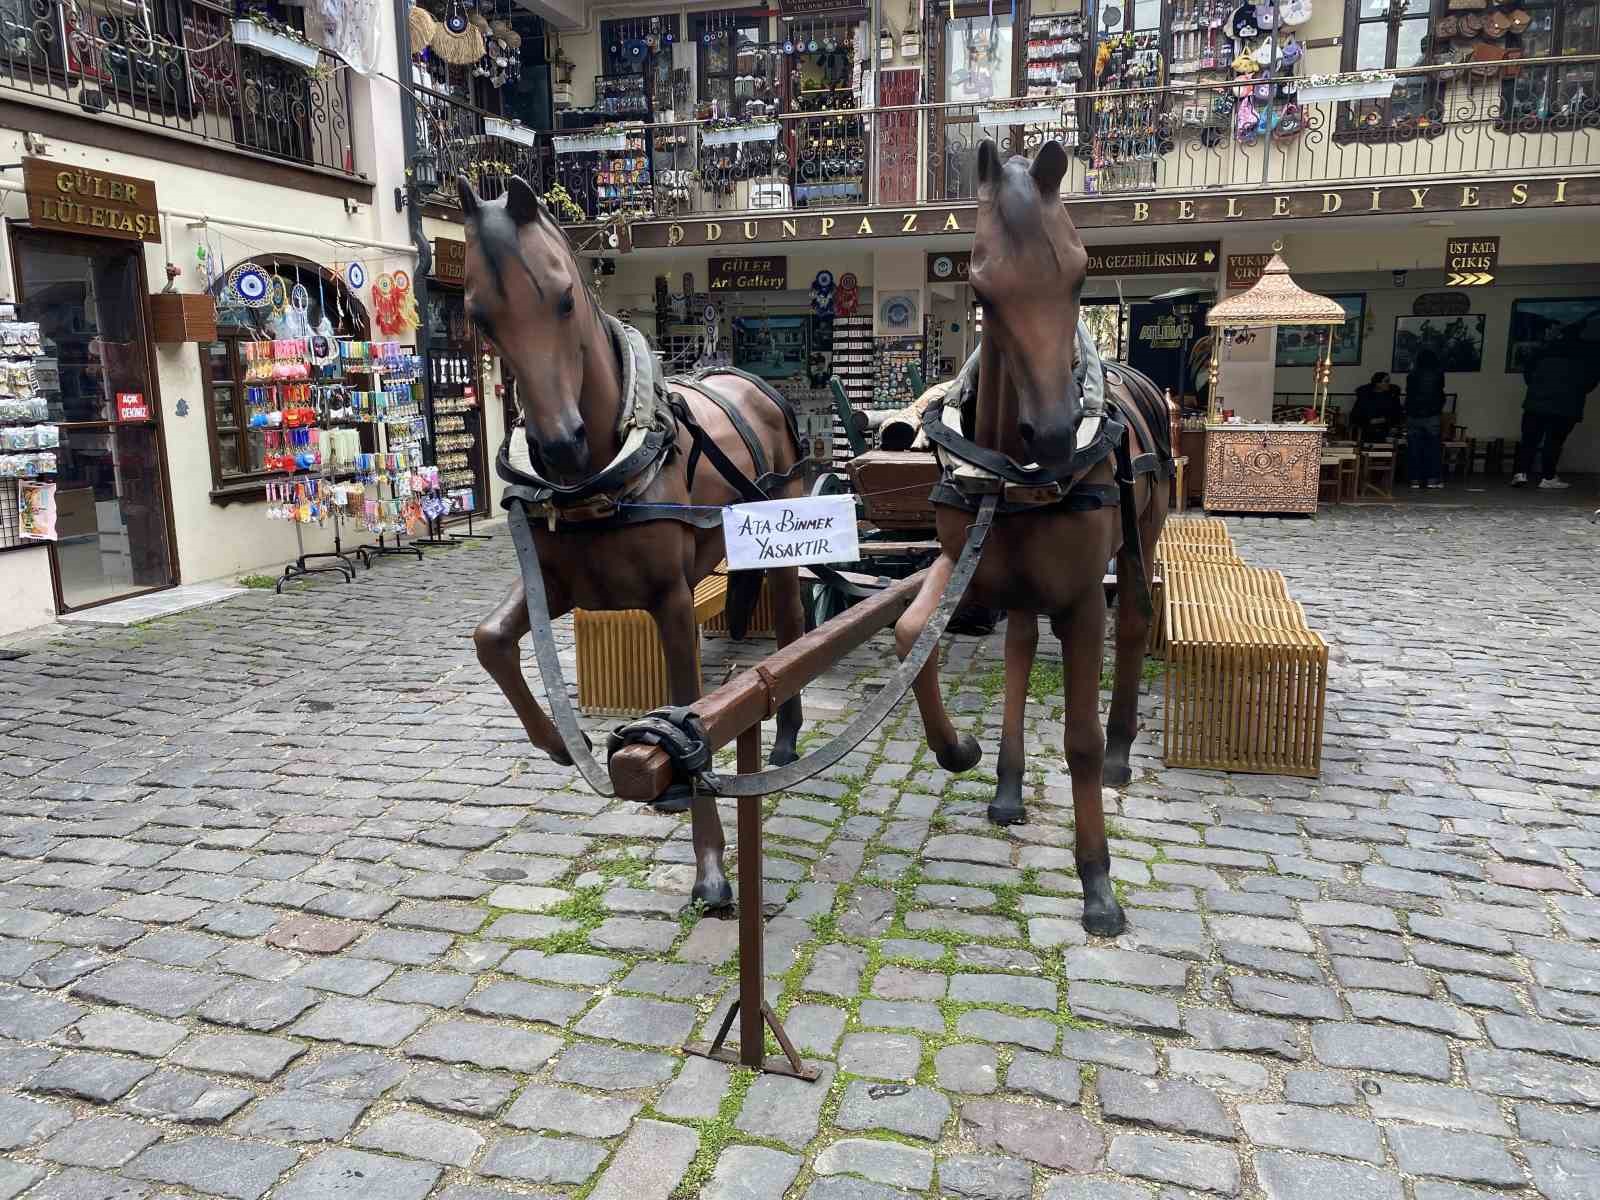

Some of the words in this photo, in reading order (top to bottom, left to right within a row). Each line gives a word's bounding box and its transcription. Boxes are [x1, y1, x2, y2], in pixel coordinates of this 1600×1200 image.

[56, 168, 138, 202] GÜLER
[41, 195, 156, 239] LÜLETAŞI
[667, 212, 961, 244] ODUNPAZA
[1132, 177, 1569, 222] BELEDİYESİ
[1471, 242, 1497, 254] KATA
[722, 258, 772, 272] GÜLER
[1105, 249, 1198, 269] GEZEBİLİRSİNİZ
[1230, 254, 1272, 266] YUKAR
[1451, 256, 1491, 271] ÇIKIŞ
[1234, 266, 1262, 280] ÇIKI
[736, 274, 785, 290] Gallery
[739, 515, 771, 536] ATA
